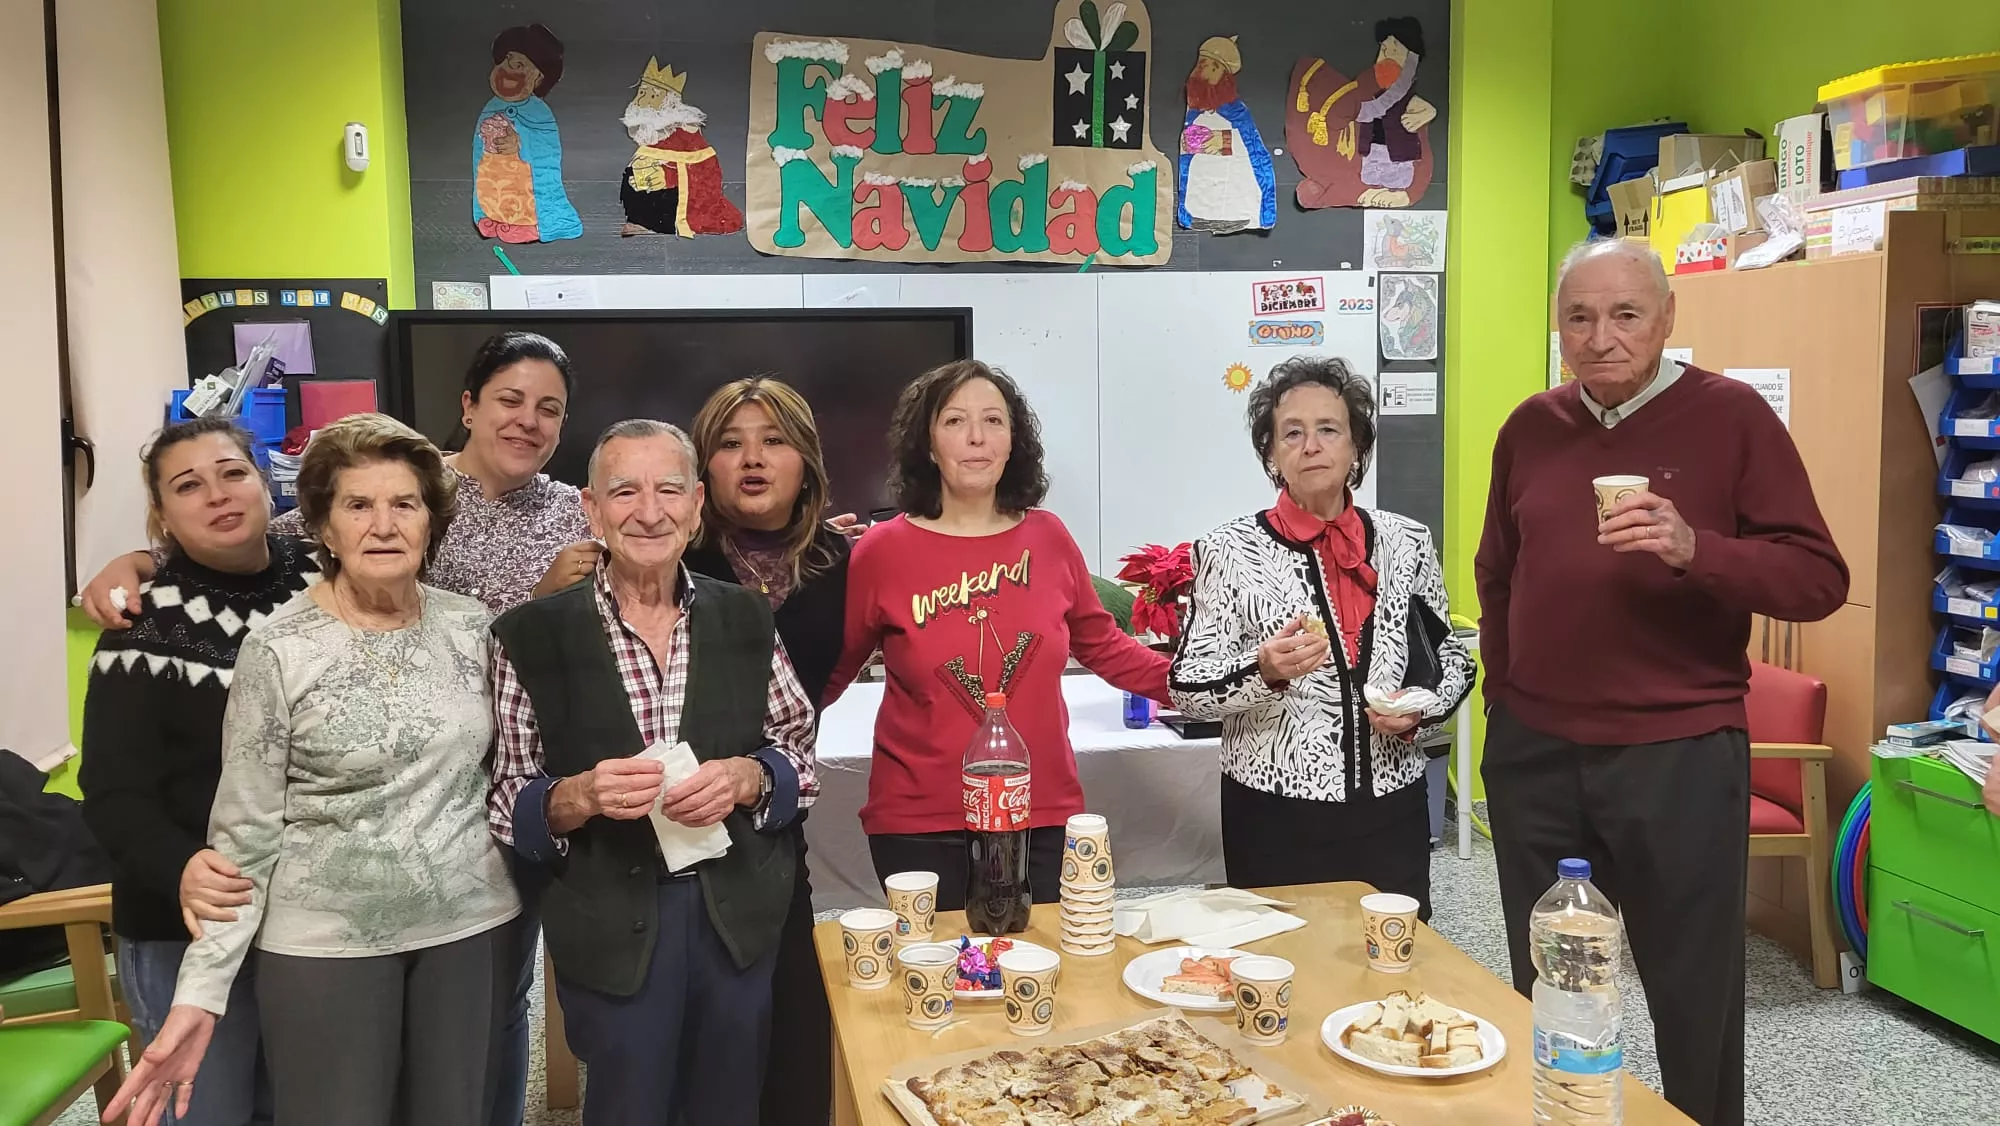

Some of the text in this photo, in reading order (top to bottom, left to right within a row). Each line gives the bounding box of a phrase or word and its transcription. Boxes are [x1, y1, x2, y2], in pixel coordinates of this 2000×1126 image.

[768, 45, 987, 155] Feliz
[1780, 139, 1788, 189] BINGO
[1795, 144, 1805, 185] LOTO
[1805, 131, 1815, 184] automatique
[773, 150, 1159, 258] Navidad
[283, 290, 329, 304] DEL
[342, 293, 388, 322] MES
[1260, 297, 1319, 313] DICIEMBRE
[1338, 298, 1374, 311] 2023
[911, 548, 1031, 627] weekend
